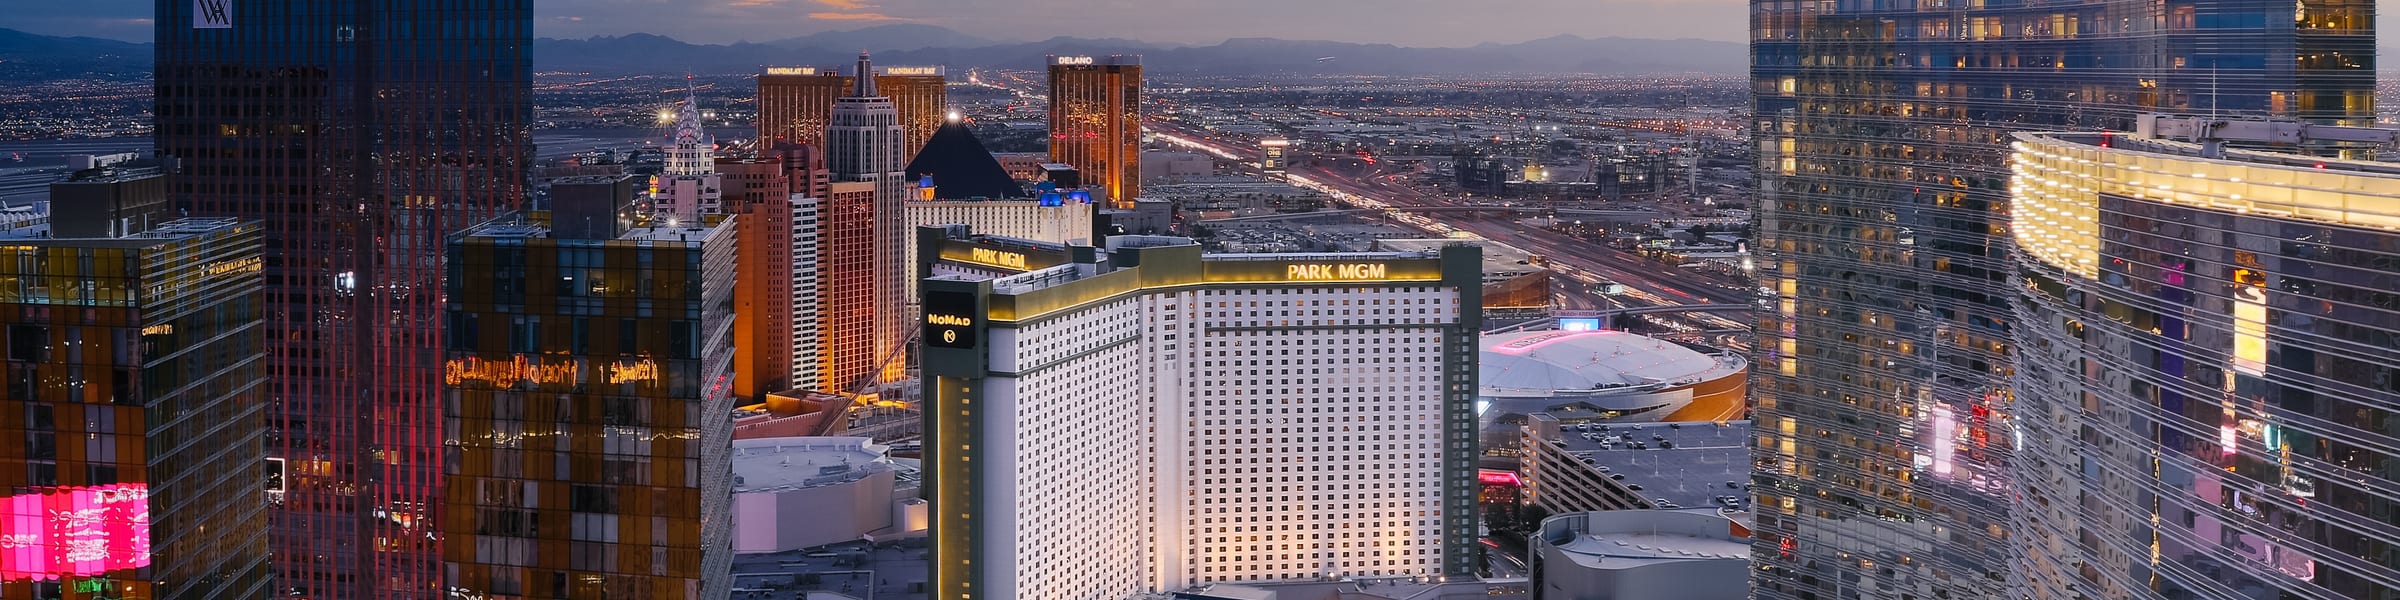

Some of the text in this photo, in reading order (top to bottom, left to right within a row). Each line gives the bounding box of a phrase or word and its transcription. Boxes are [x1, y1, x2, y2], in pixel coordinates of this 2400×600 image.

[1058, 56, 1093, 65] DELANO
[767, 67, 815, 75] MANDALAY BAY
[887, 67, 936, 75] MANDALAY BAY
[973, 247, 1025, 268] PARK MGM
[1287, 263, 1385, 280] PARK MGM
